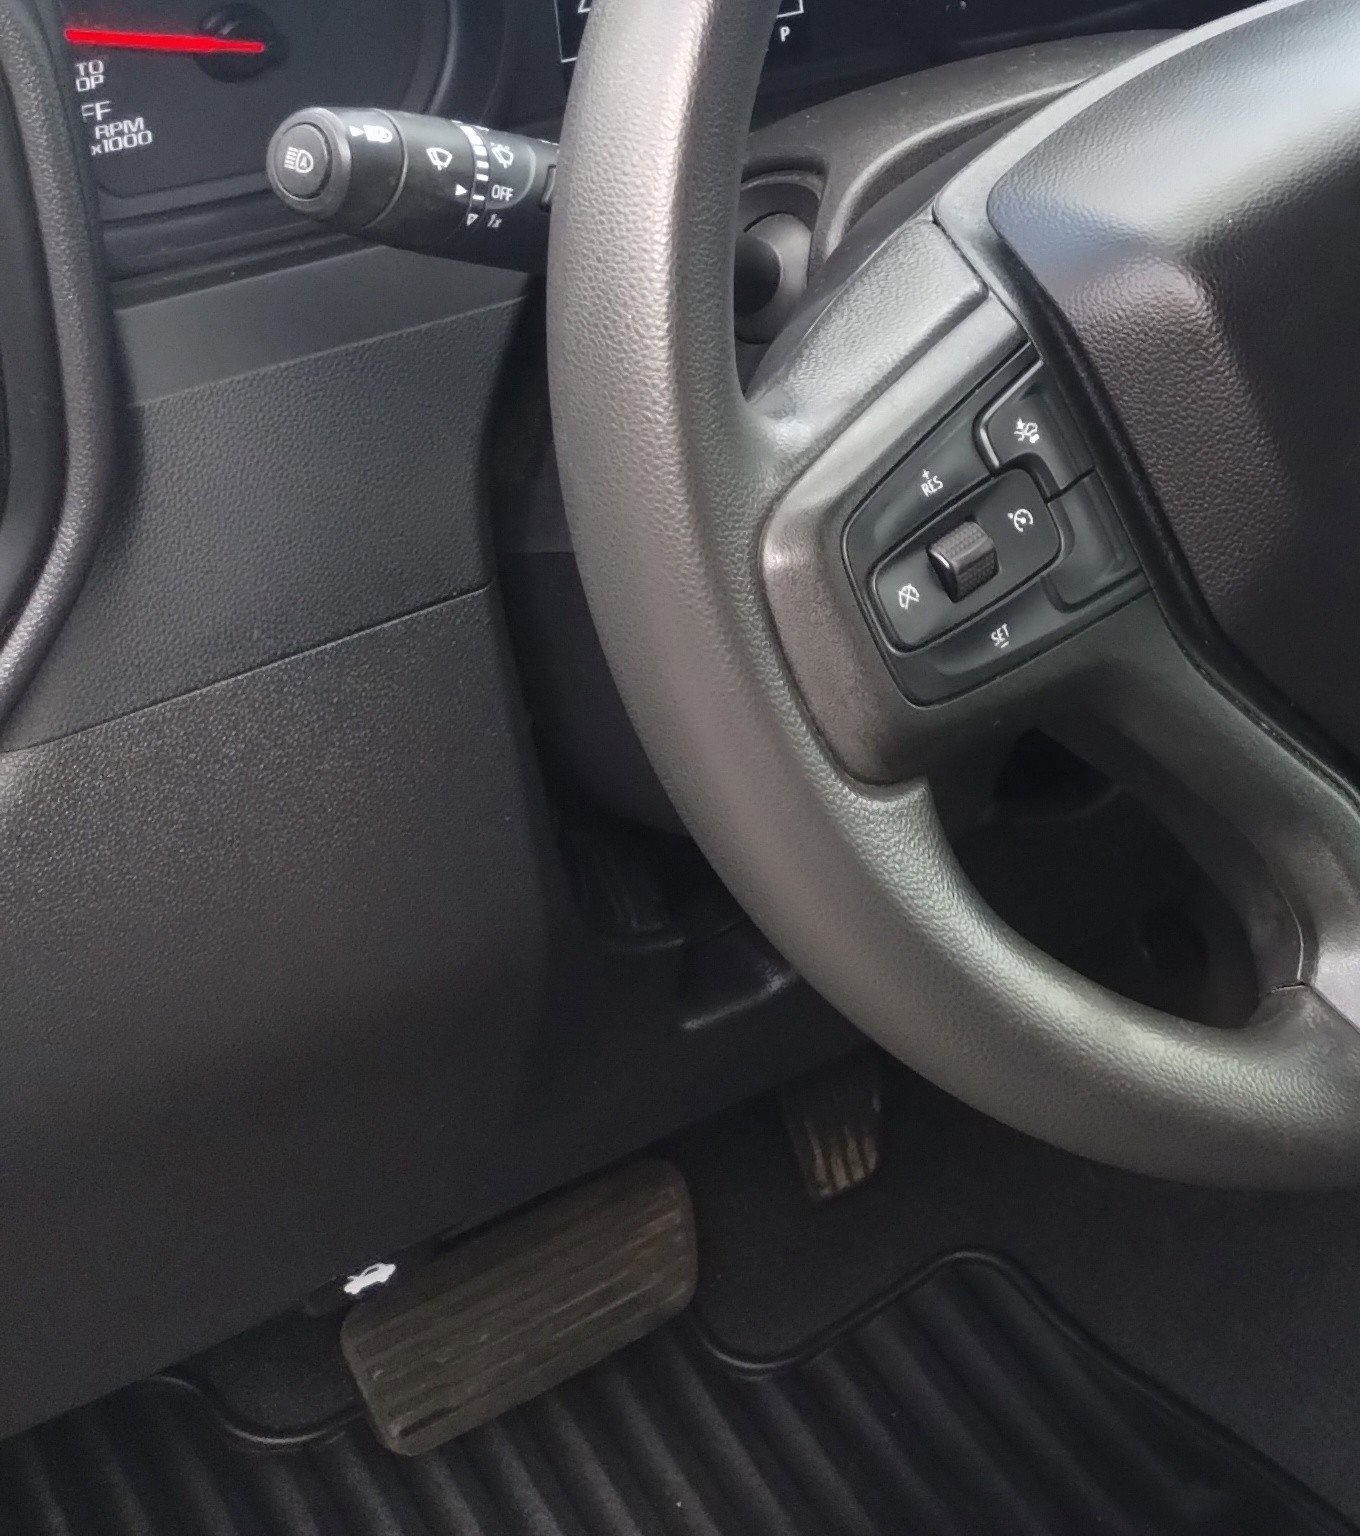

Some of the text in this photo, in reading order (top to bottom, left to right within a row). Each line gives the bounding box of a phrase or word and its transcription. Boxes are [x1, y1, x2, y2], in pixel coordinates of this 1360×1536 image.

[780, 27, 791, 42] P
[95, 117, 145, 140] RPM
[90, 130, 153, 156] x1000
[491, 184, 513, 202] OFF
[921, 475, 944, 496] RES
[990, 622, 1010, 646] SET
